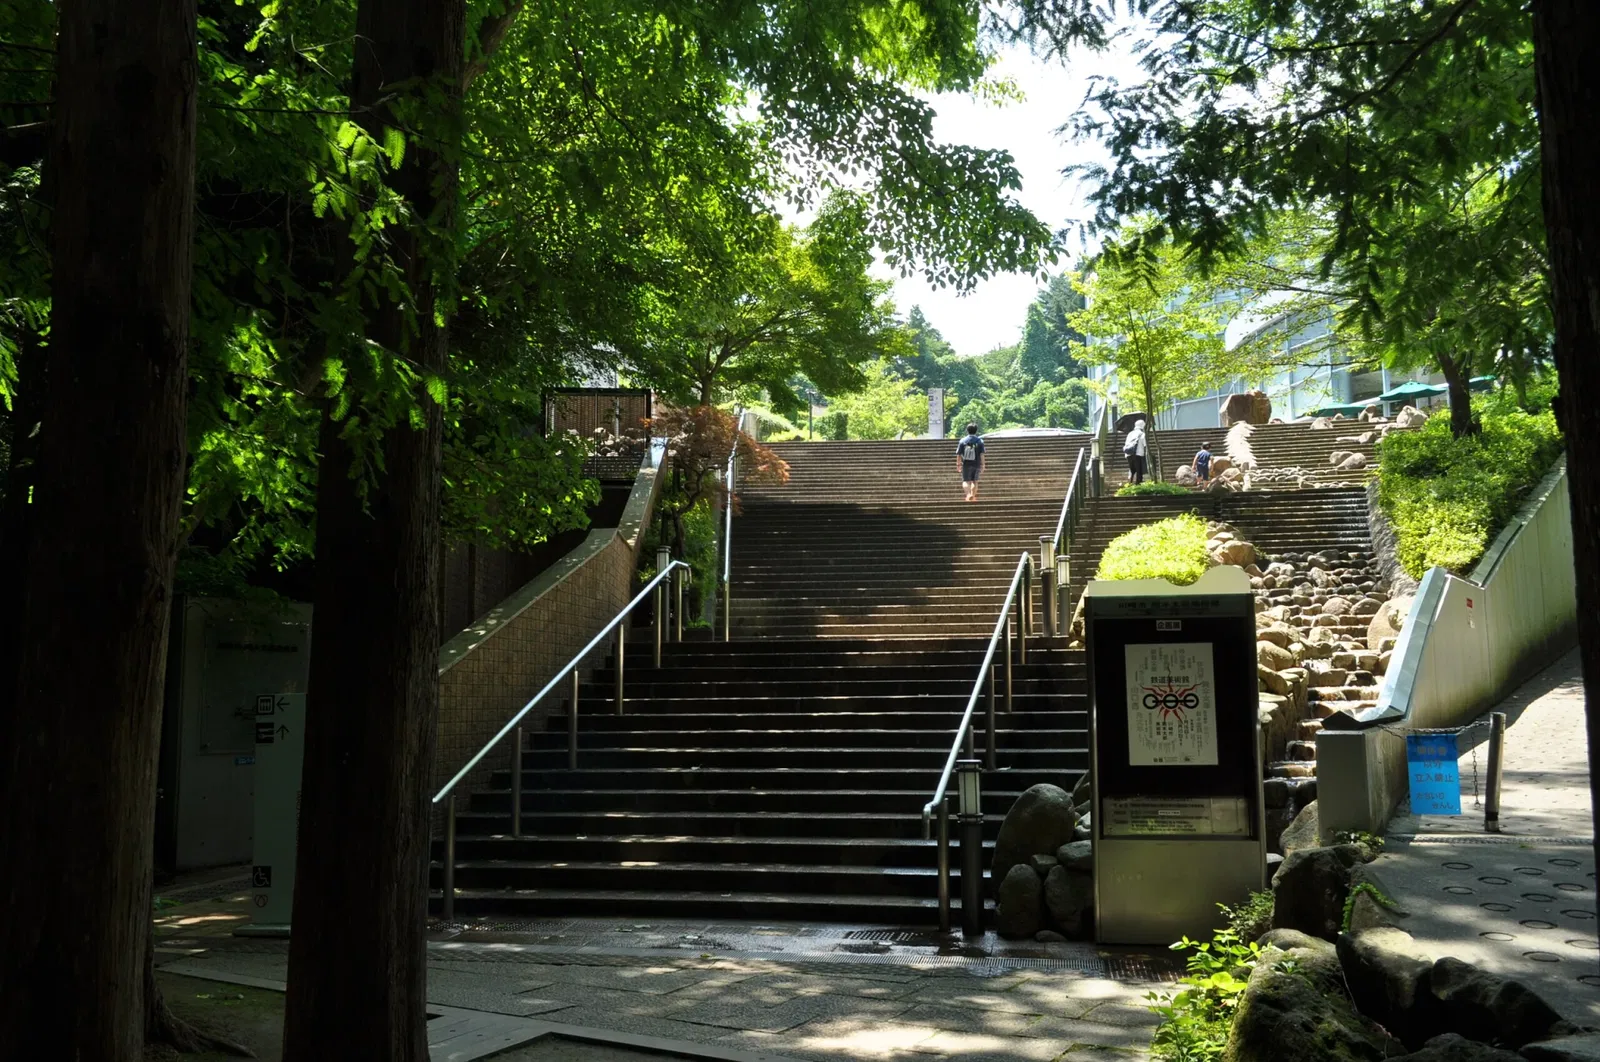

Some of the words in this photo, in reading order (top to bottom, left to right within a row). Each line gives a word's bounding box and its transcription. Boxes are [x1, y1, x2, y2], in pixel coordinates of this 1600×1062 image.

[1157, 621, 1181, 630] 企画展
[1415, 774, 1454, 782] 立入禁止
